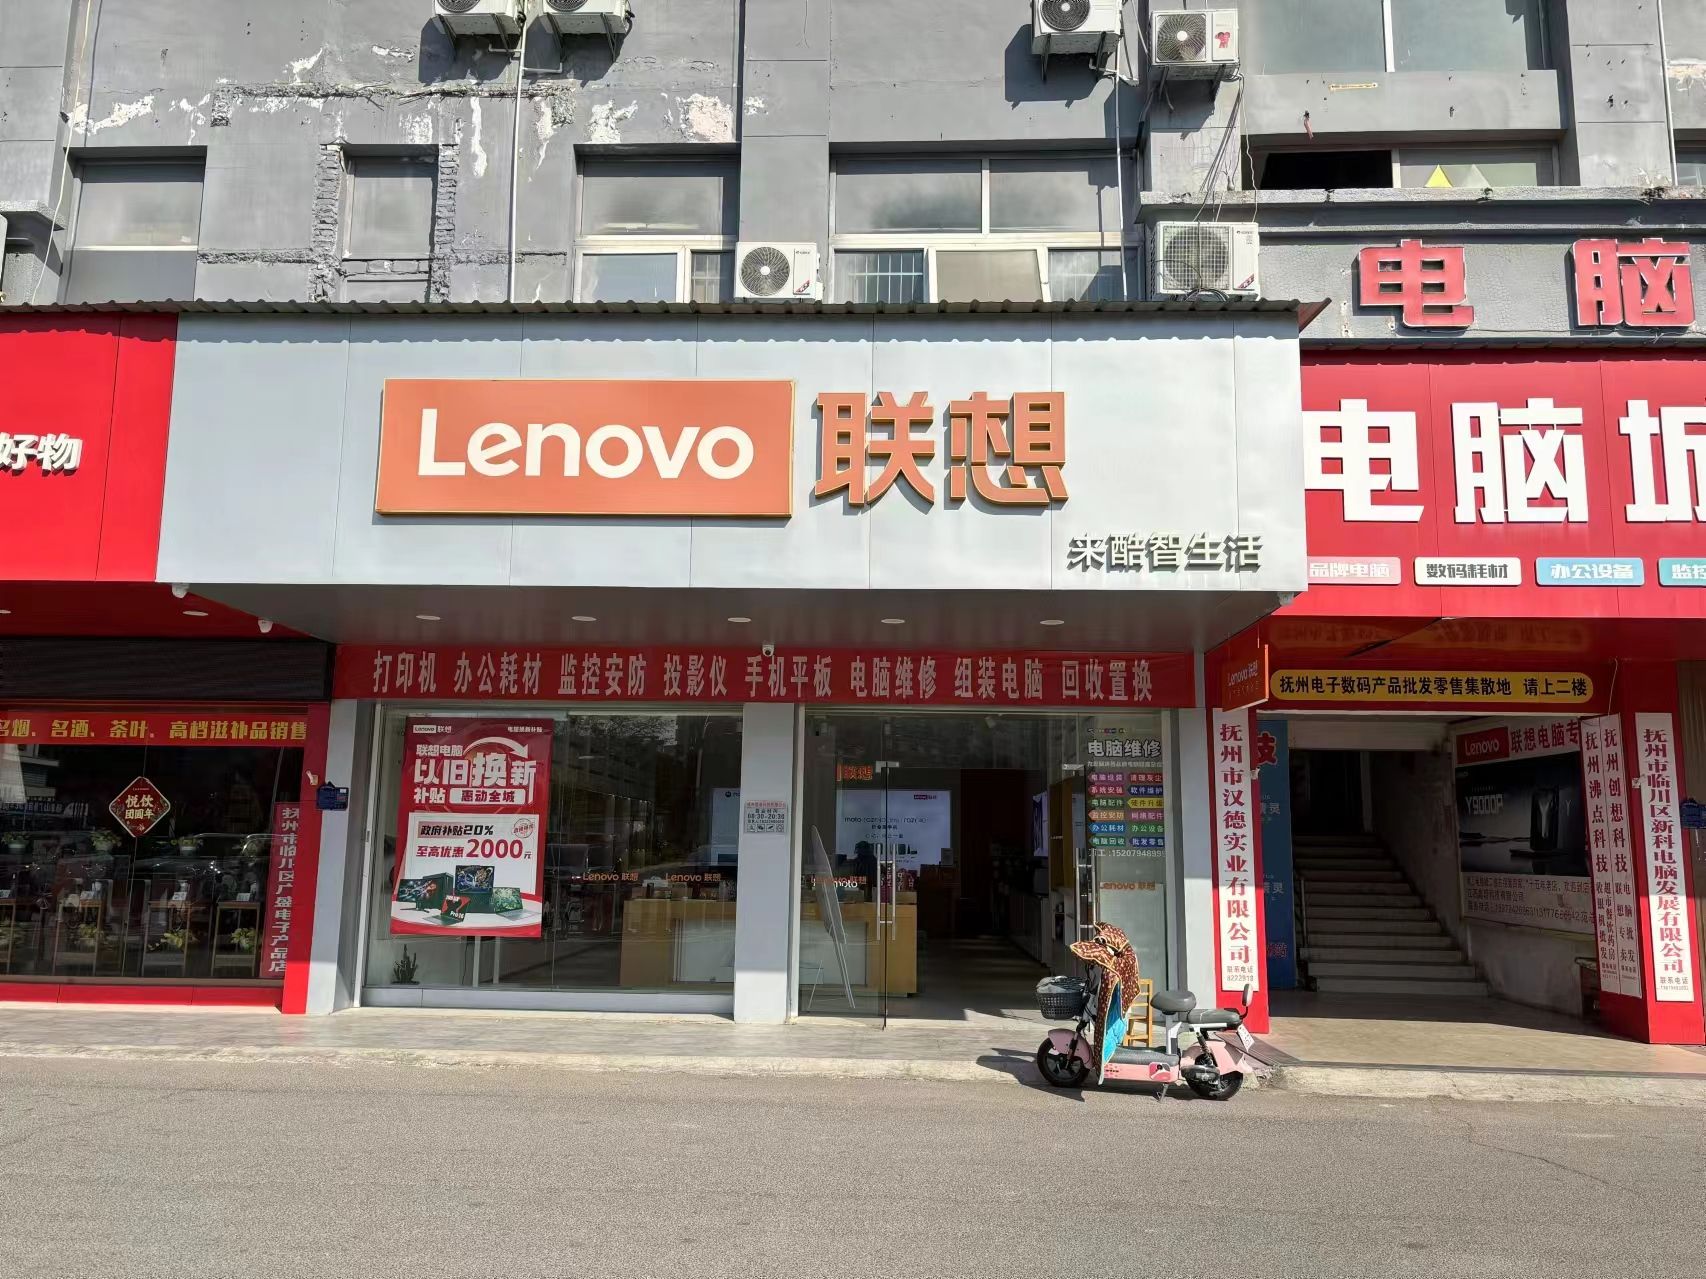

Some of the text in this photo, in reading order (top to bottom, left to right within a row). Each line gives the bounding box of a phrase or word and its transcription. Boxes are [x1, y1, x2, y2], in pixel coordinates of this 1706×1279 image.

[0, 432, 83, 470] 好物
[418, 408, 754, 479] Lenovo
[814, 391, 1069, 505] 联想
[1070, 531, 1261, 568] 来酷智生活
[1308, 562, 1390, 579] 品牌电脑
[1426, 562, 1508, 580] 数码耗材
[1550, 562, 1634, 580] 办公设备
[373, 650, 1153, 702] 打印机 办公耗材 监控安防 投影仪 手机平板 电脑维修 组装电脑 回收置换
[1279, 675, 1512, 696] 抚州电子数码产品批发零售集散地
[1524, 677, 1588, 697] 请上二楼
[416, 744, 464, 757] 联想电脑
[1087, 739, 1161, 758] 电脑维修
[1464, 740, 1500, 756] Lenovo
[414, 752, 536, 792] 以旧换新
[414, 787, 515, 804] 补贴 惠动全城
[1585, 732, 1609, 873] 抚州沸点科技
[1604, 728, 1628, 873] 抚州创想科技
[420, 824, 494, 836] 政府补贴20%
[416, 838, 532, 860] 至高优惠2000元
[1219, 723, 1252, 964] 抚州市汉德实业有限公司
[1643, 728, 1684, 974] 抚州市临川区新科电脑发展有限公司
[582, 873, 620, 882] Lenovo
[665, 872, 702, 883] Lenovo
